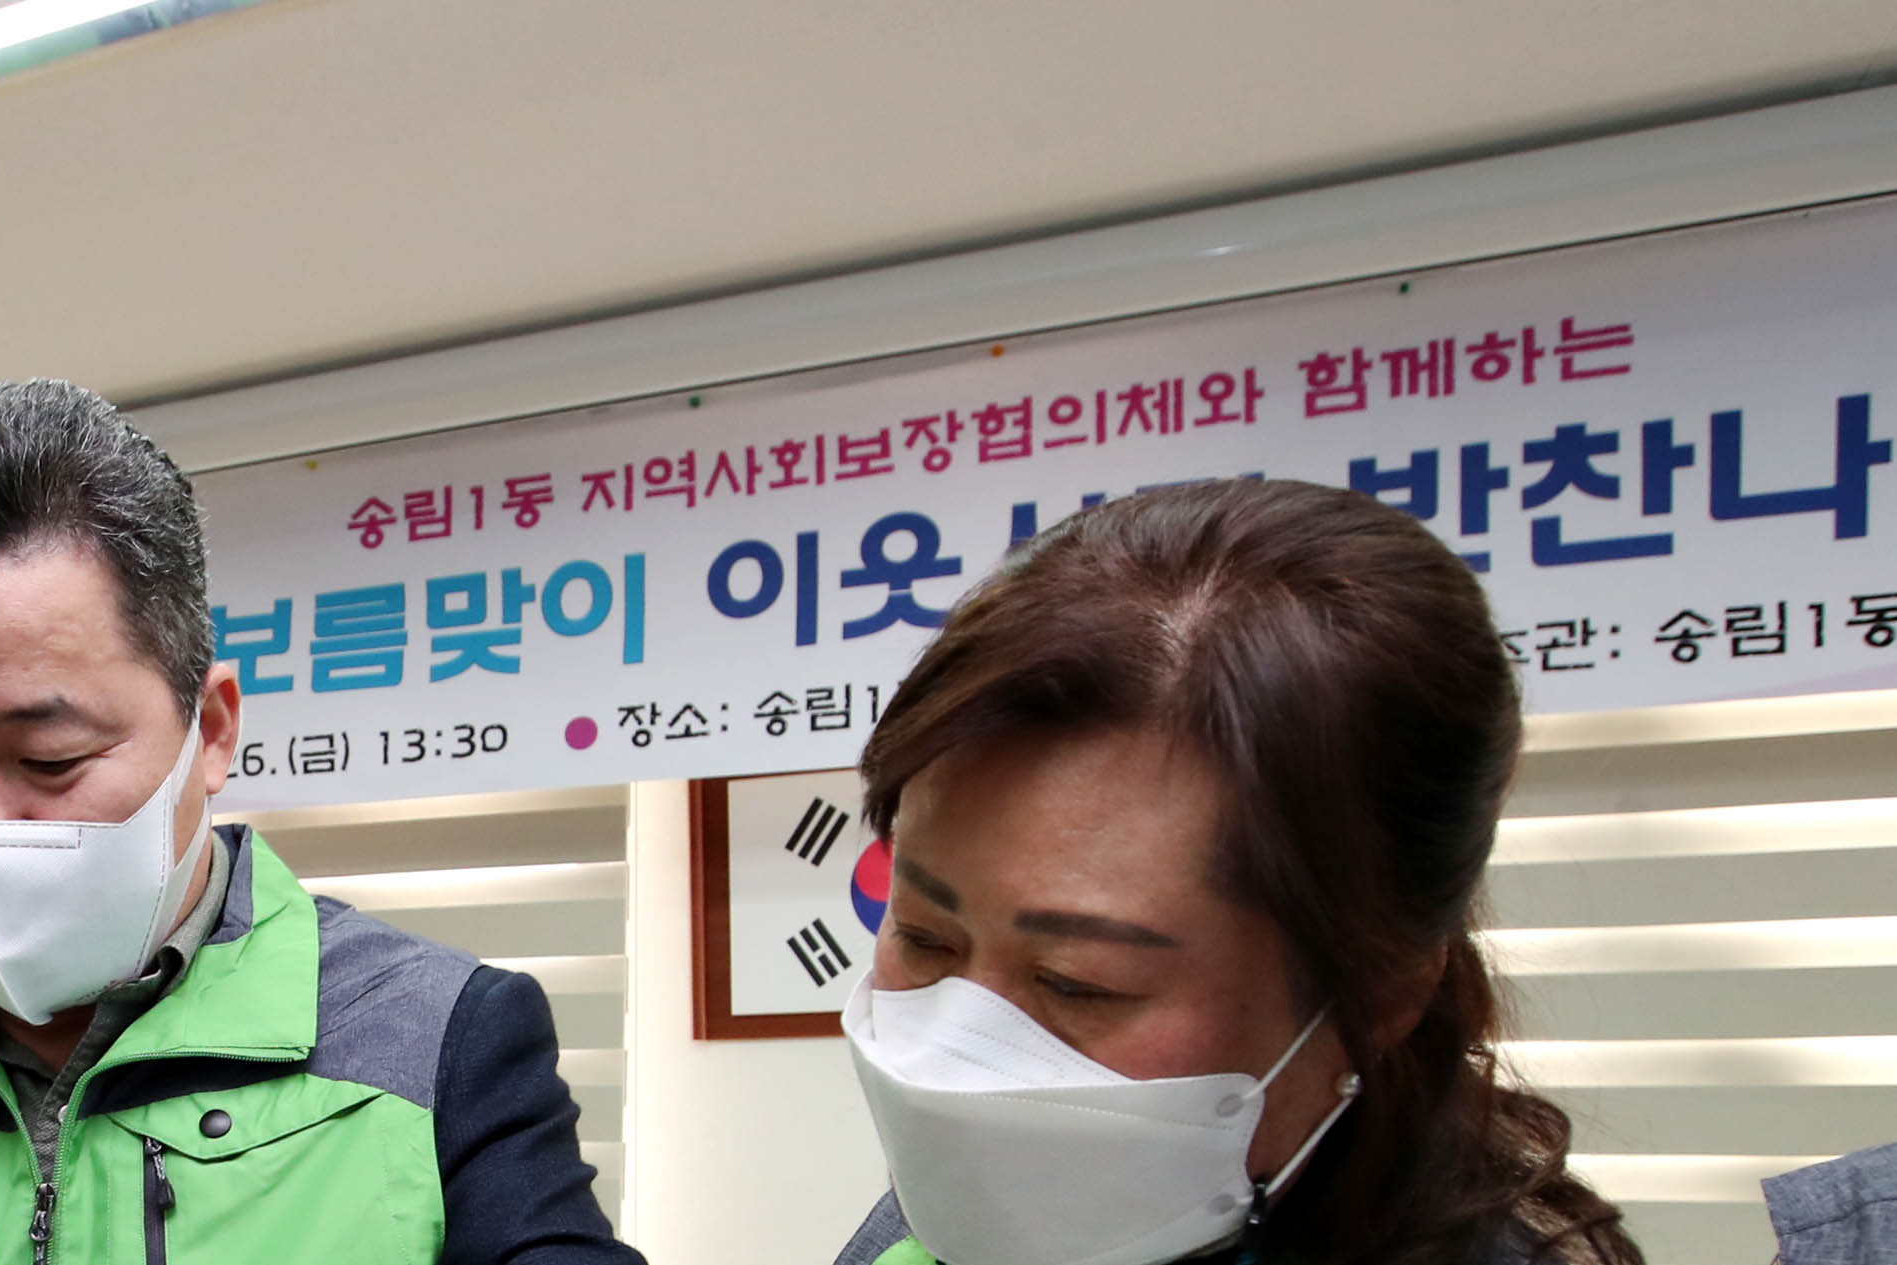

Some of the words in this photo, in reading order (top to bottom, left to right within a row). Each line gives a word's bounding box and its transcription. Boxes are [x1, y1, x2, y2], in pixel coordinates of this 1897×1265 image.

[347, 472, 555, 551] 송림1동
[580, 366, 1265, 513] 지역사회보장협의체와
[1298, 316, 1635, 418] 함께하는
[210, 552, 646, 696] 보름맞이
[1654, 591, 1897, 665] 송림1동
[226, 730, 350, 779] 6.(금)
[379, 722, 509, 766] 13:30
[617, 701, 729, 749] 장소:
[753, 681, 903, 737] 송림1
